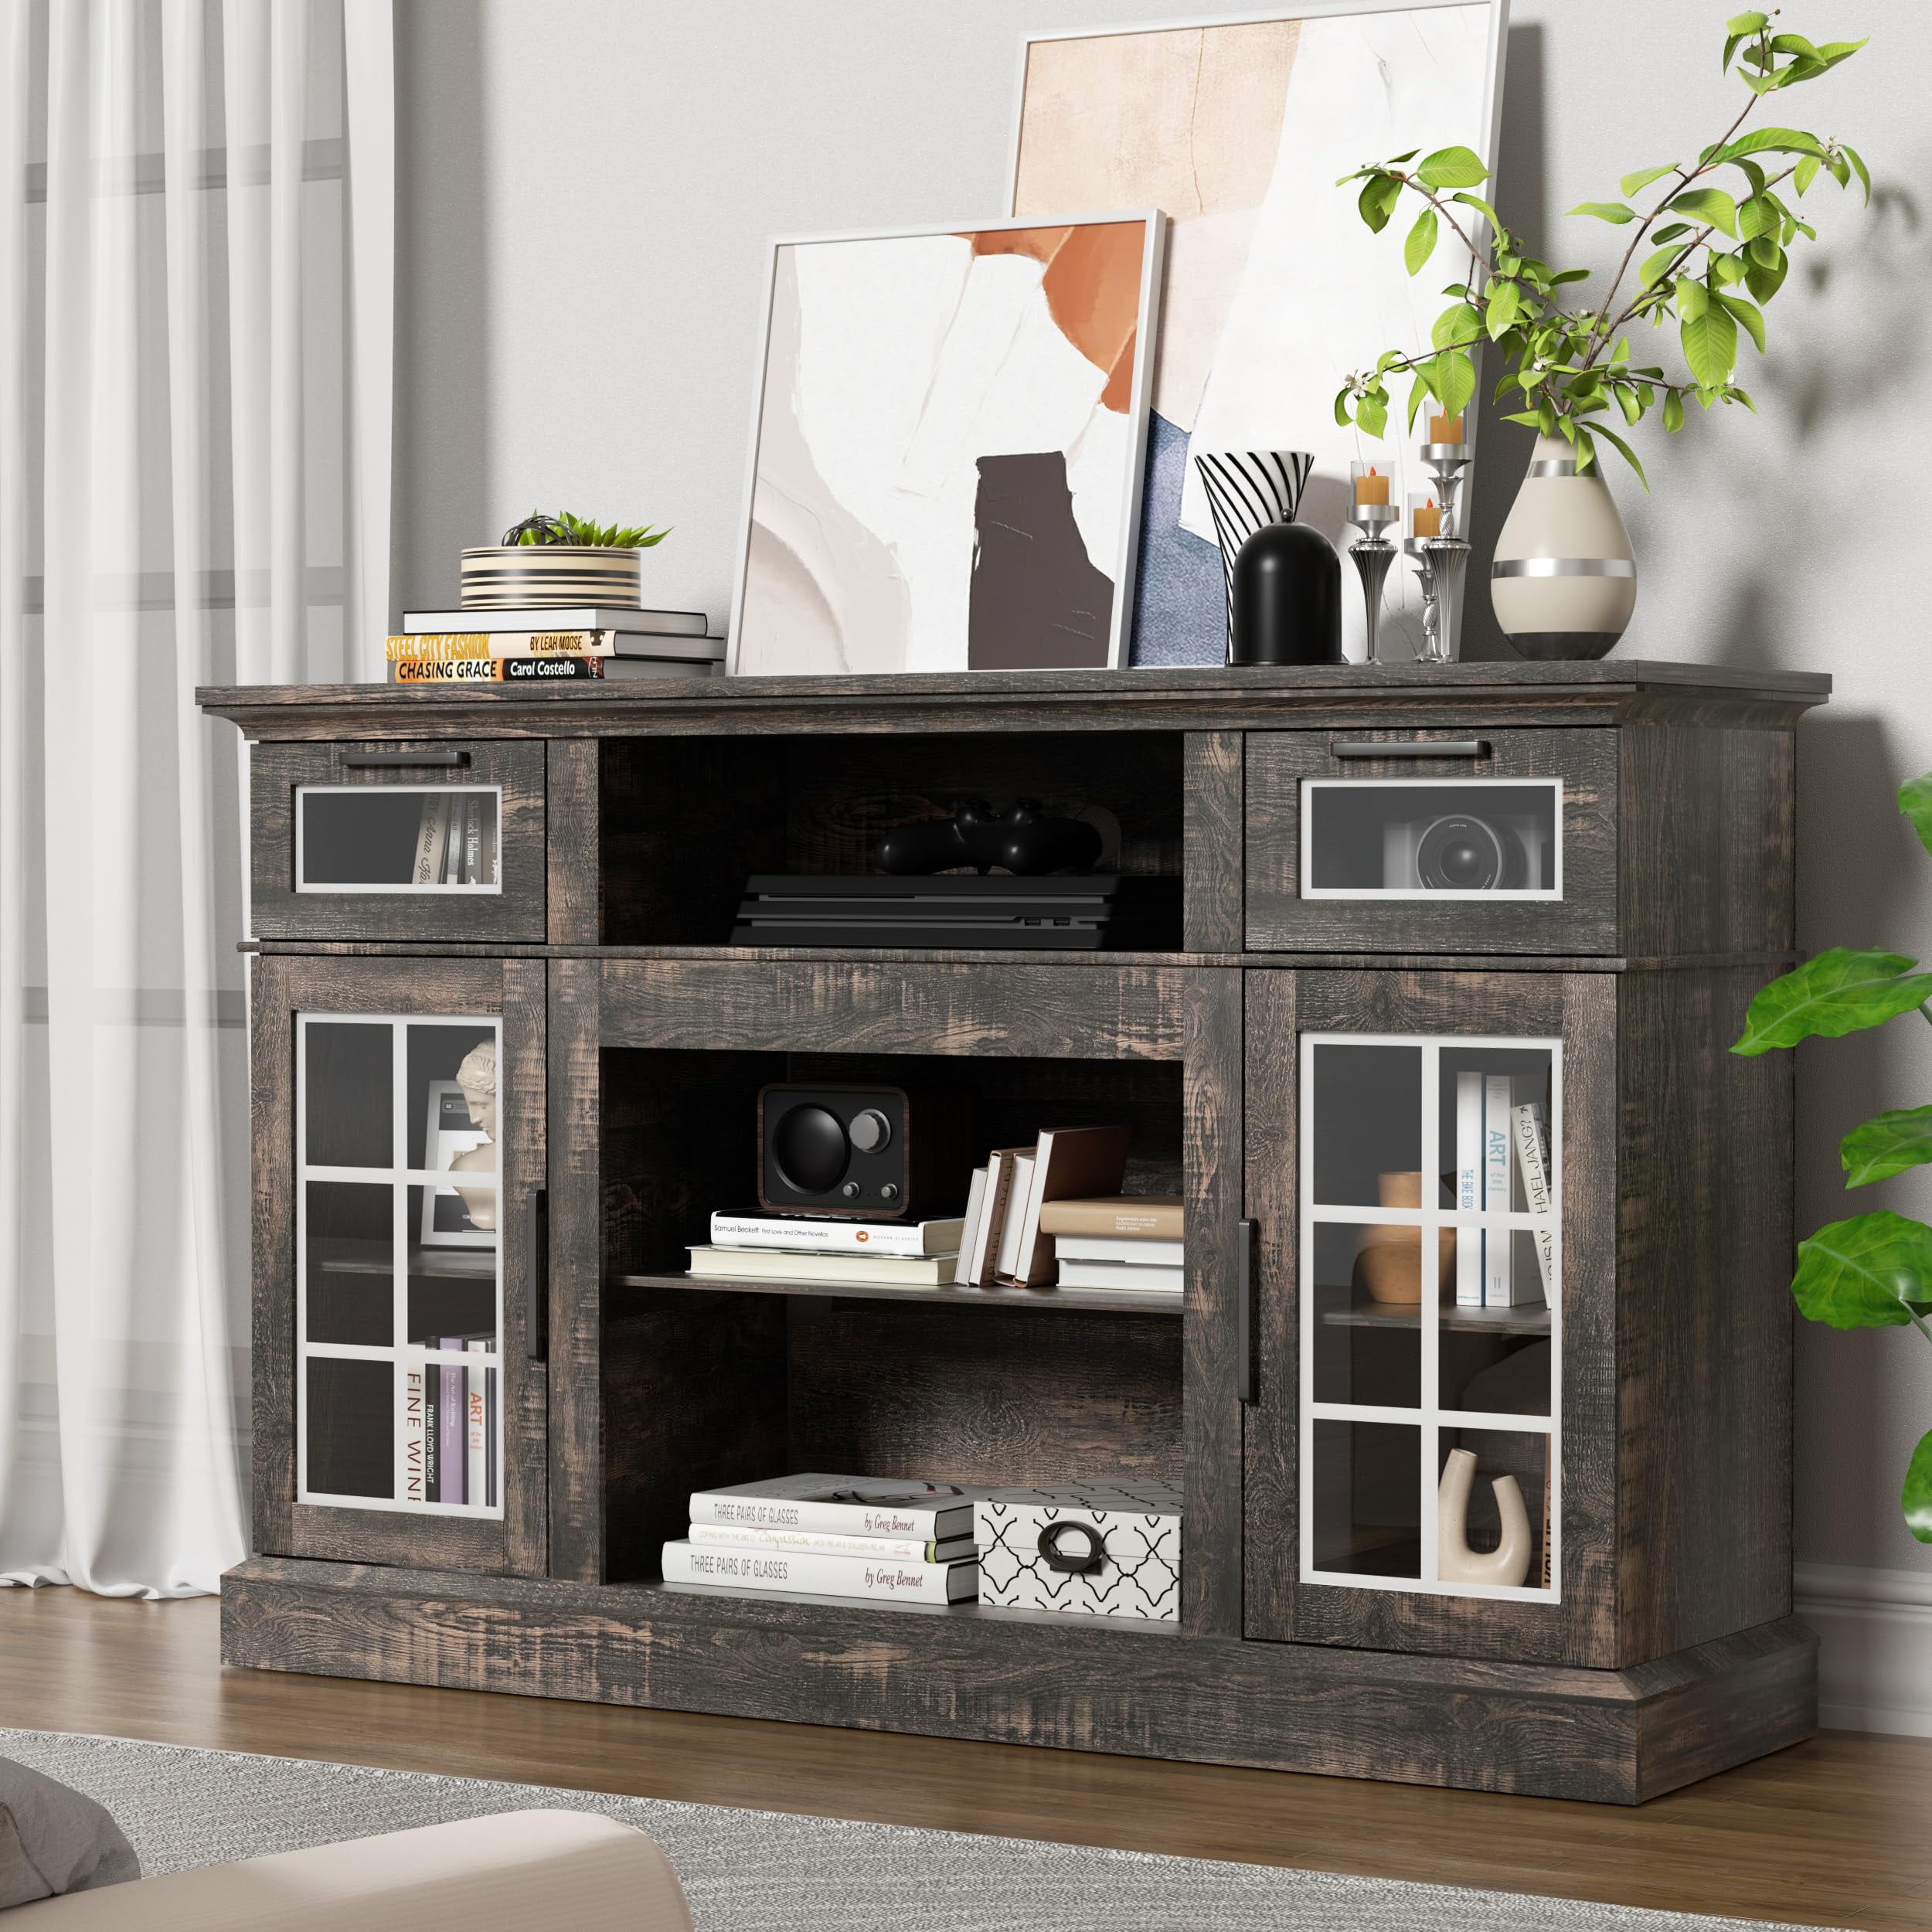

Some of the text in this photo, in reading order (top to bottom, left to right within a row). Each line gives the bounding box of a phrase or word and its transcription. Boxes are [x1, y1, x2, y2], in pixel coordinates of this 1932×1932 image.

[386, 633, 490, 661] STEEL CITY FASHION
[529, 635, 583, 650] BY LEAH MOOSE
[399, 661, 497, 679] CHASING GRACE
[510, 660, 575, 676] Carol Costello
[467, 800, 478, 866] Sherlock Holmes
[1489, 1130, 1506, 1167] ART
[1519, 1120, 1539, 1169] JANG?
[714, 1224, 736, 1233] Samuel
[407, 1373, 421, 1428] FINE
[470, 1392, 483, 1427] ART
[426, 1404, 434, 1484] FRANK LLOYD WRIGHT
[714, 1503, 798, 1525] THREE PAIRS OF GLASSES
[865, 1512, 915, 1532] by Greg Bennet
[690, 1554, 788, 1580] THREE PAIRS OF GLASSES
[865, 1567, 923, 1590] by Greg Bennet
